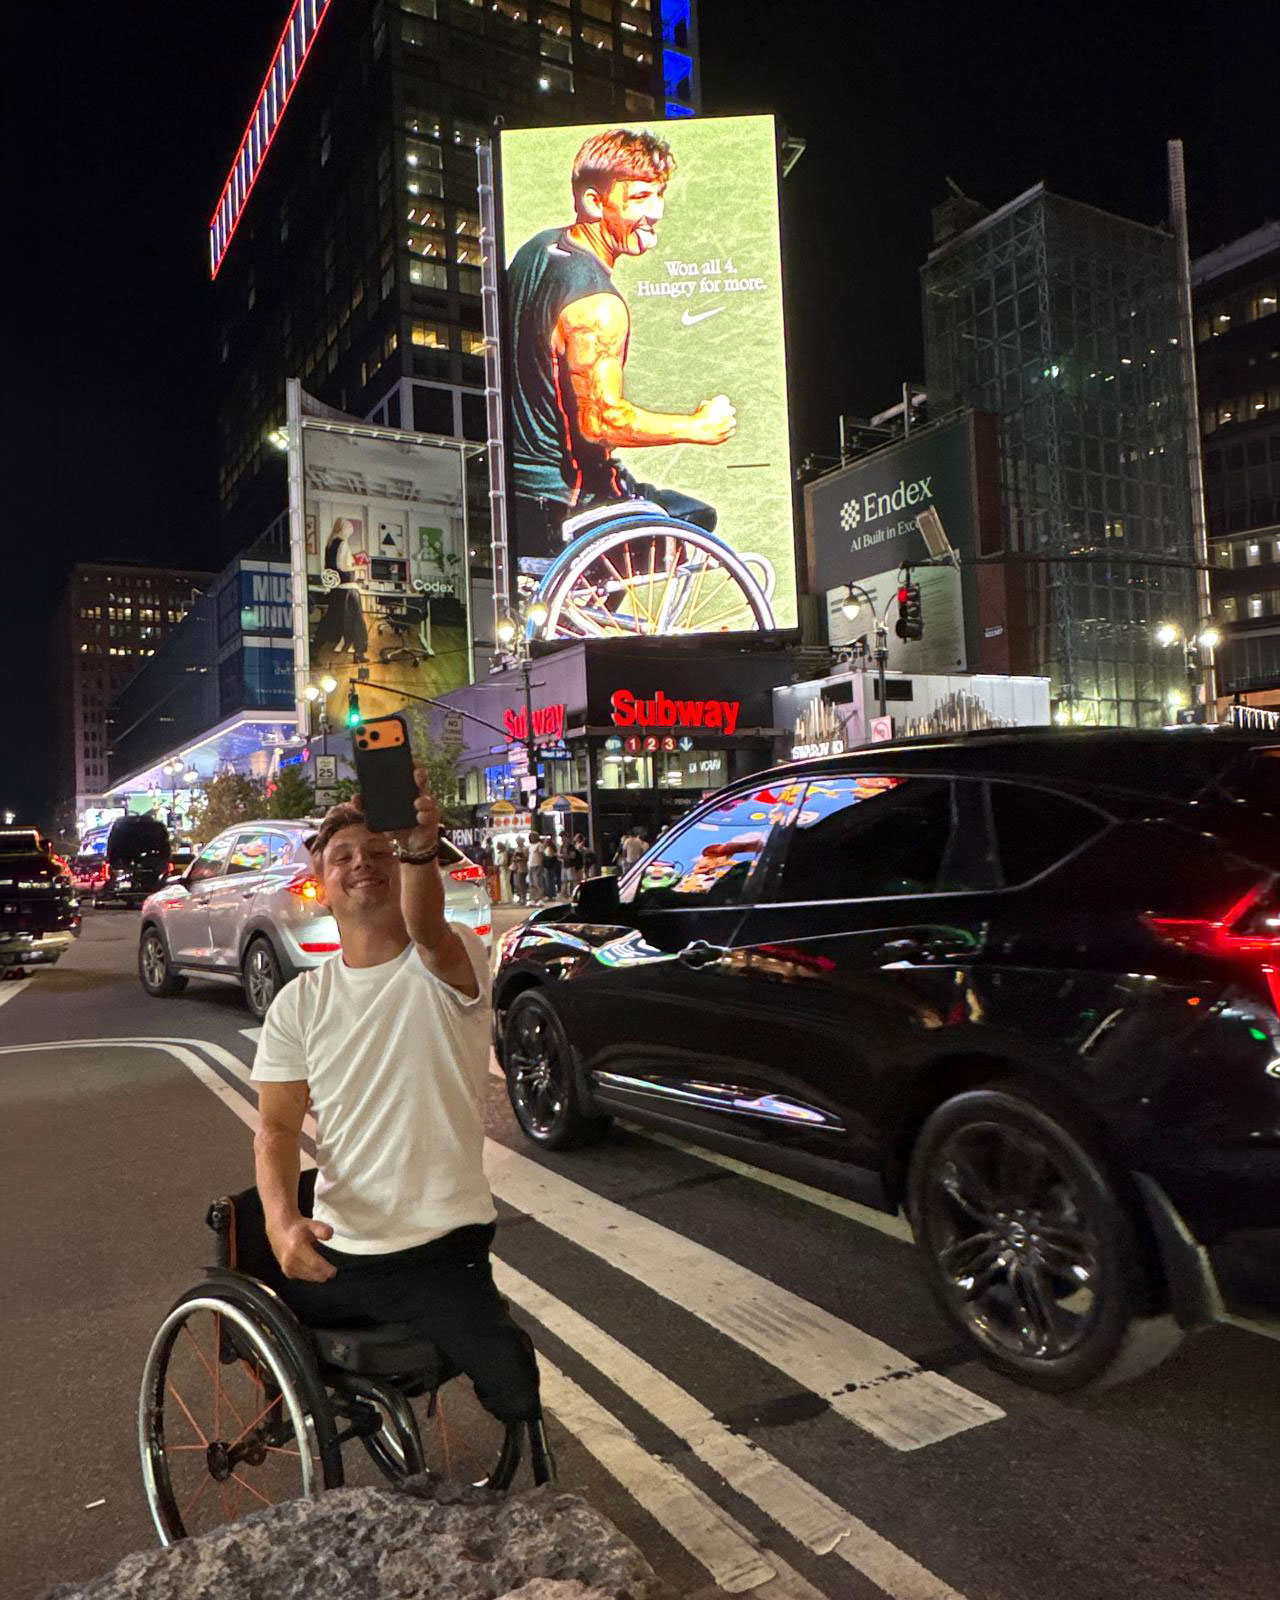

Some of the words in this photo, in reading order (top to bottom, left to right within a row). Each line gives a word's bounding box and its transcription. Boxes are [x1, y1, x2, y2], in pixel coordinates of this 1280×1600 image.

[664, 261, 699, 276] Won
[702, 259, 721, 274] all
[724, 257, 738, 273] 4.
[637, 281, 697, 297] Hungry
[699, 277, 720, 292] for
[724, 278, 767, 291] more.
[863, 476, 933, 522] Endex
[850, 537, 861, 553] AI
[863, 530, 885, 548] Built
[886, 526, 896, 540] in
[253, 575, 293, 603] MUS
[413, 579, 454, 593] Codex
[253, 605, 293, 627] UNIV
[611, 690, 739, 735] Subway
[648, 738, 656, 750] 2
[665, 738, 674, 750] 3
[319, 768, 333, 778] 25
[452, 828, 473, 847] PENN
